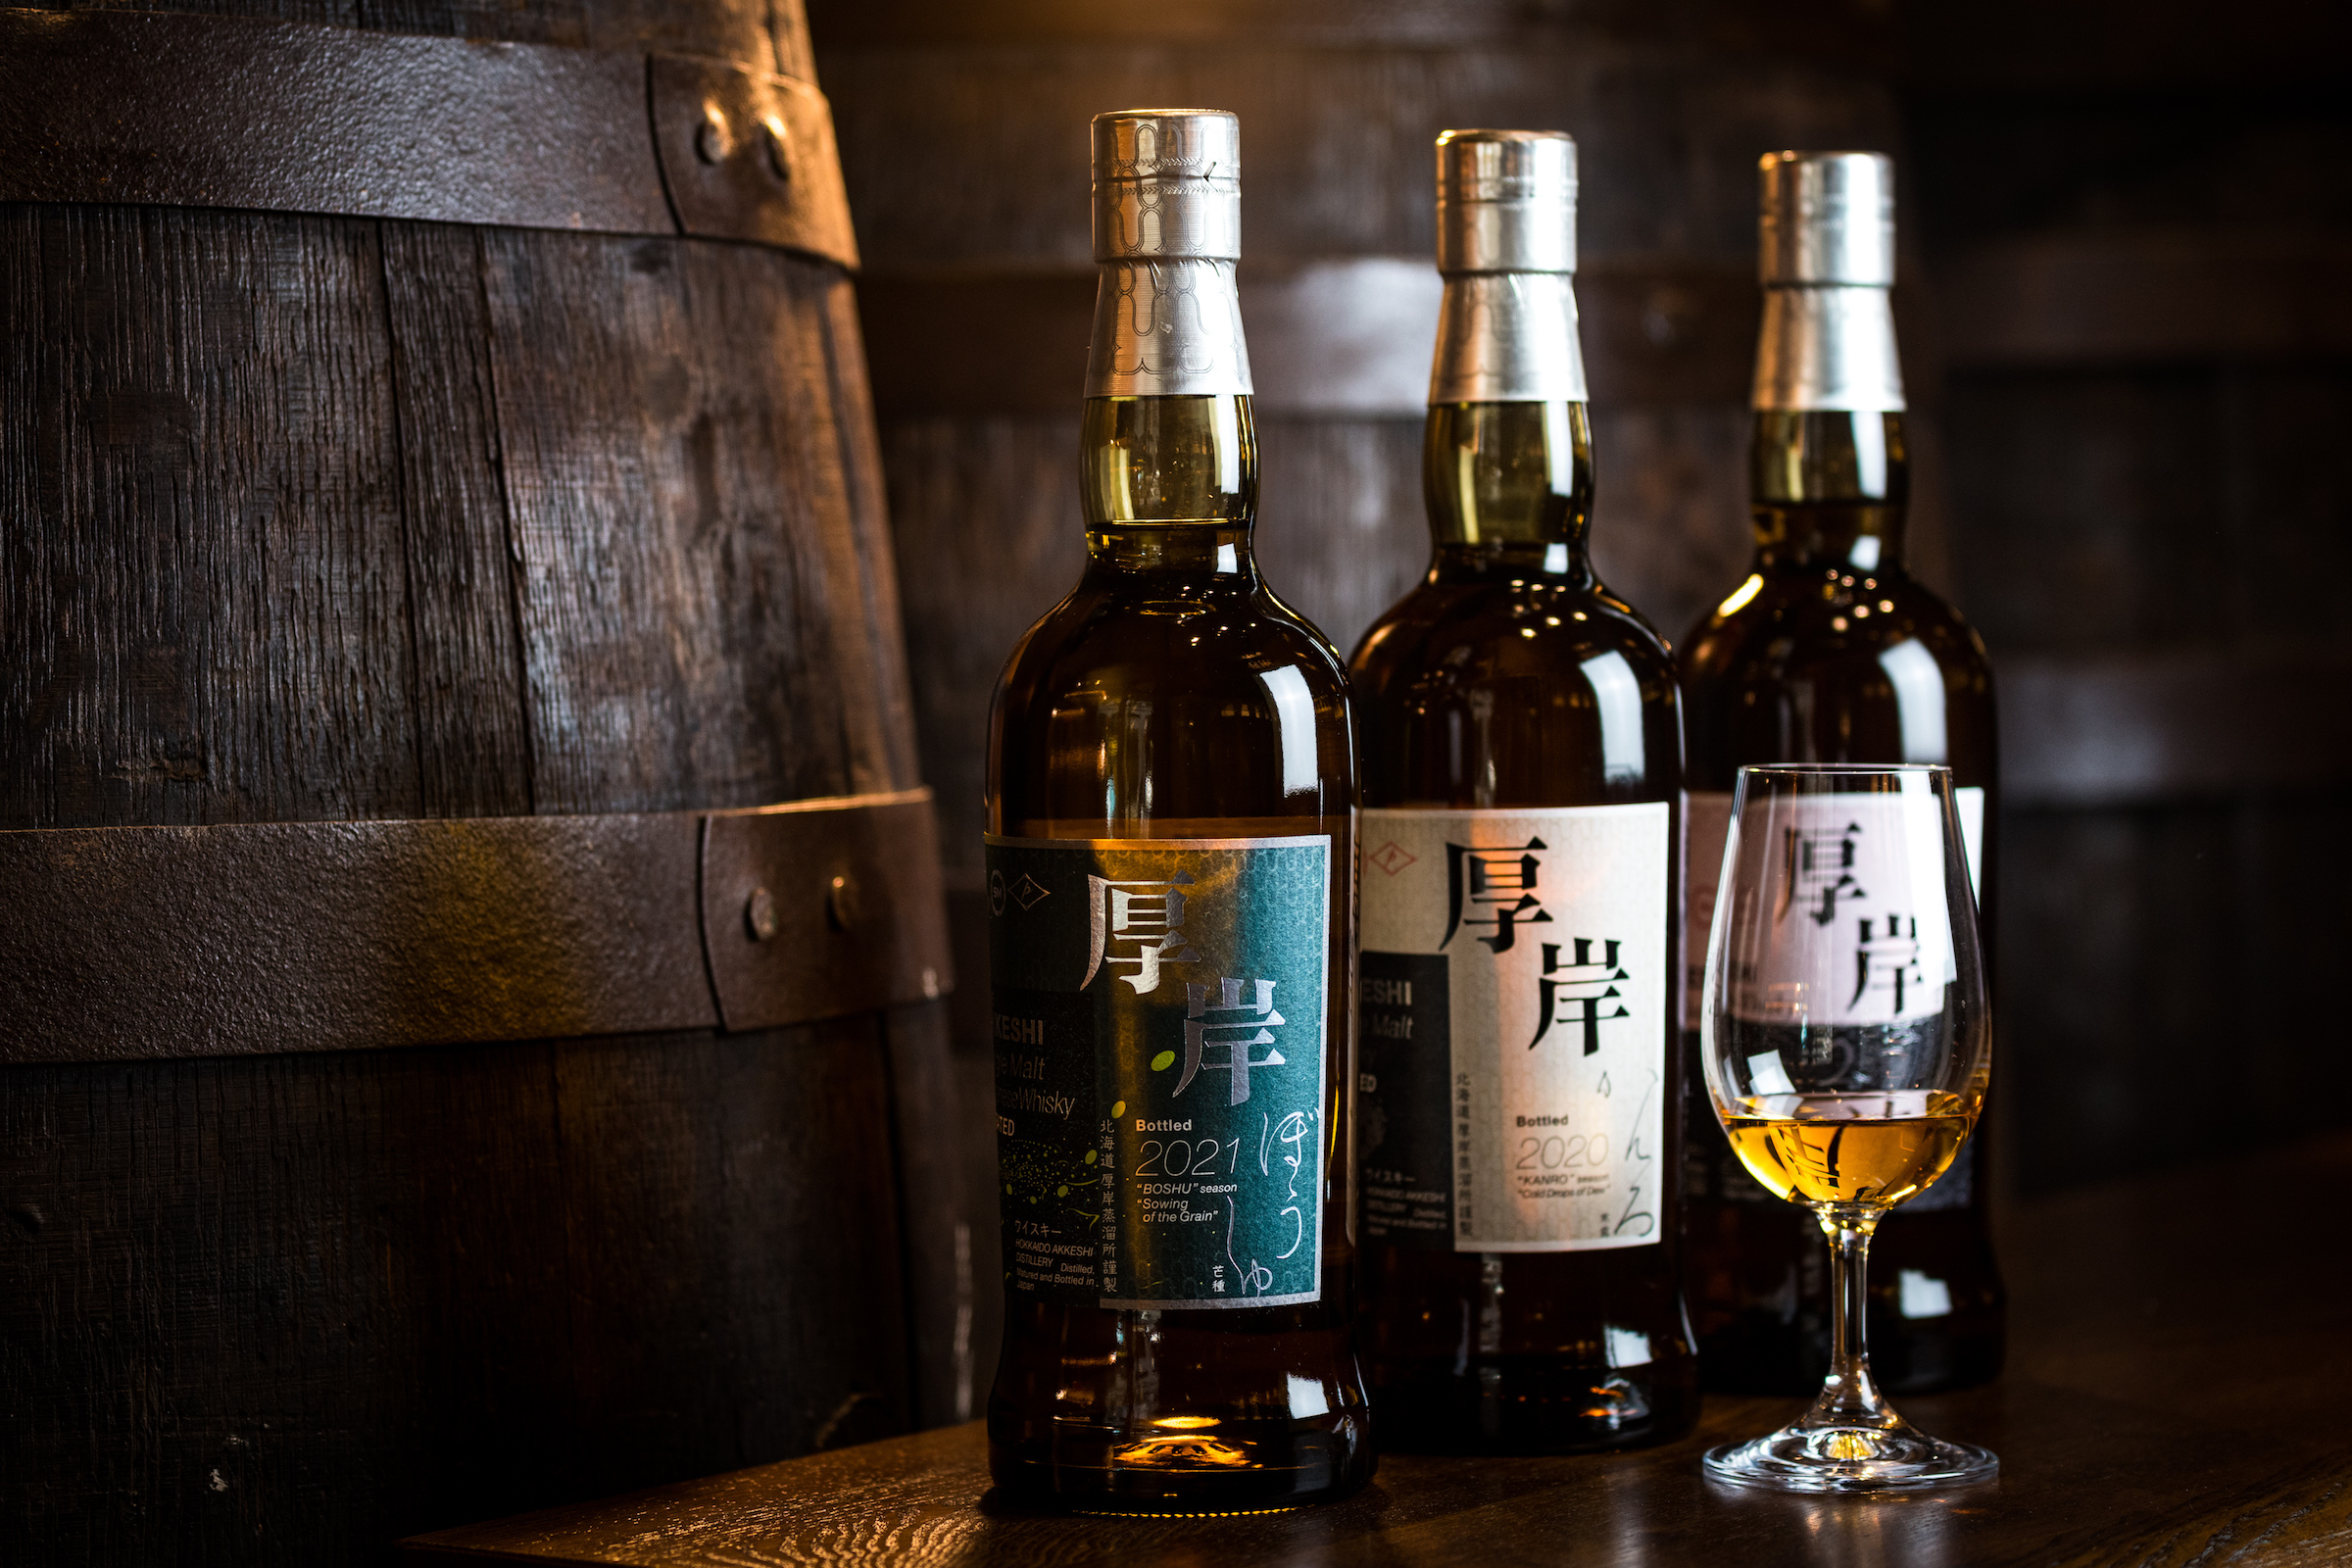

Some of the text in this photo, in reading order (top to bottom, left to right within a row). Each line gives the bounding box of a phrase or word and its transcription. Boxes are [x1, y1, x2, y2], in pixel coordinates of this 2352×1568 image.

[1440, 836, 1630, 1056] 厚岸
[1079, 869, 1286, 1105] 厚岸
[1009, 1054, 1046, 1081] Malt
[1136, 1119, 1193, 1132] Bottled
[1516, 1113, 1568, 1127] Bottled
[1135, 1137, 1240, 1177] 2021
[1516, 1133, 1609, 1169] 2020
[1200, 1183, 1238, 1194] season
[1143, 1211, 1156, 1223] of
[1157, 1211, 1177, 1222] the
[1014, 1219, 1062, 1238] ウイスキー
[1052, 1244, 1095, 1257] AKKESHI
[1060, 1262, 1096, 1275] Distilled,
[1039, 1273, 1053, 1283] and
[1054, 1273, 1085, 1286] Bottled
[1086, 1277, 1096, 1286] in
[1212, 1265, 1227, 1294] 芒種
